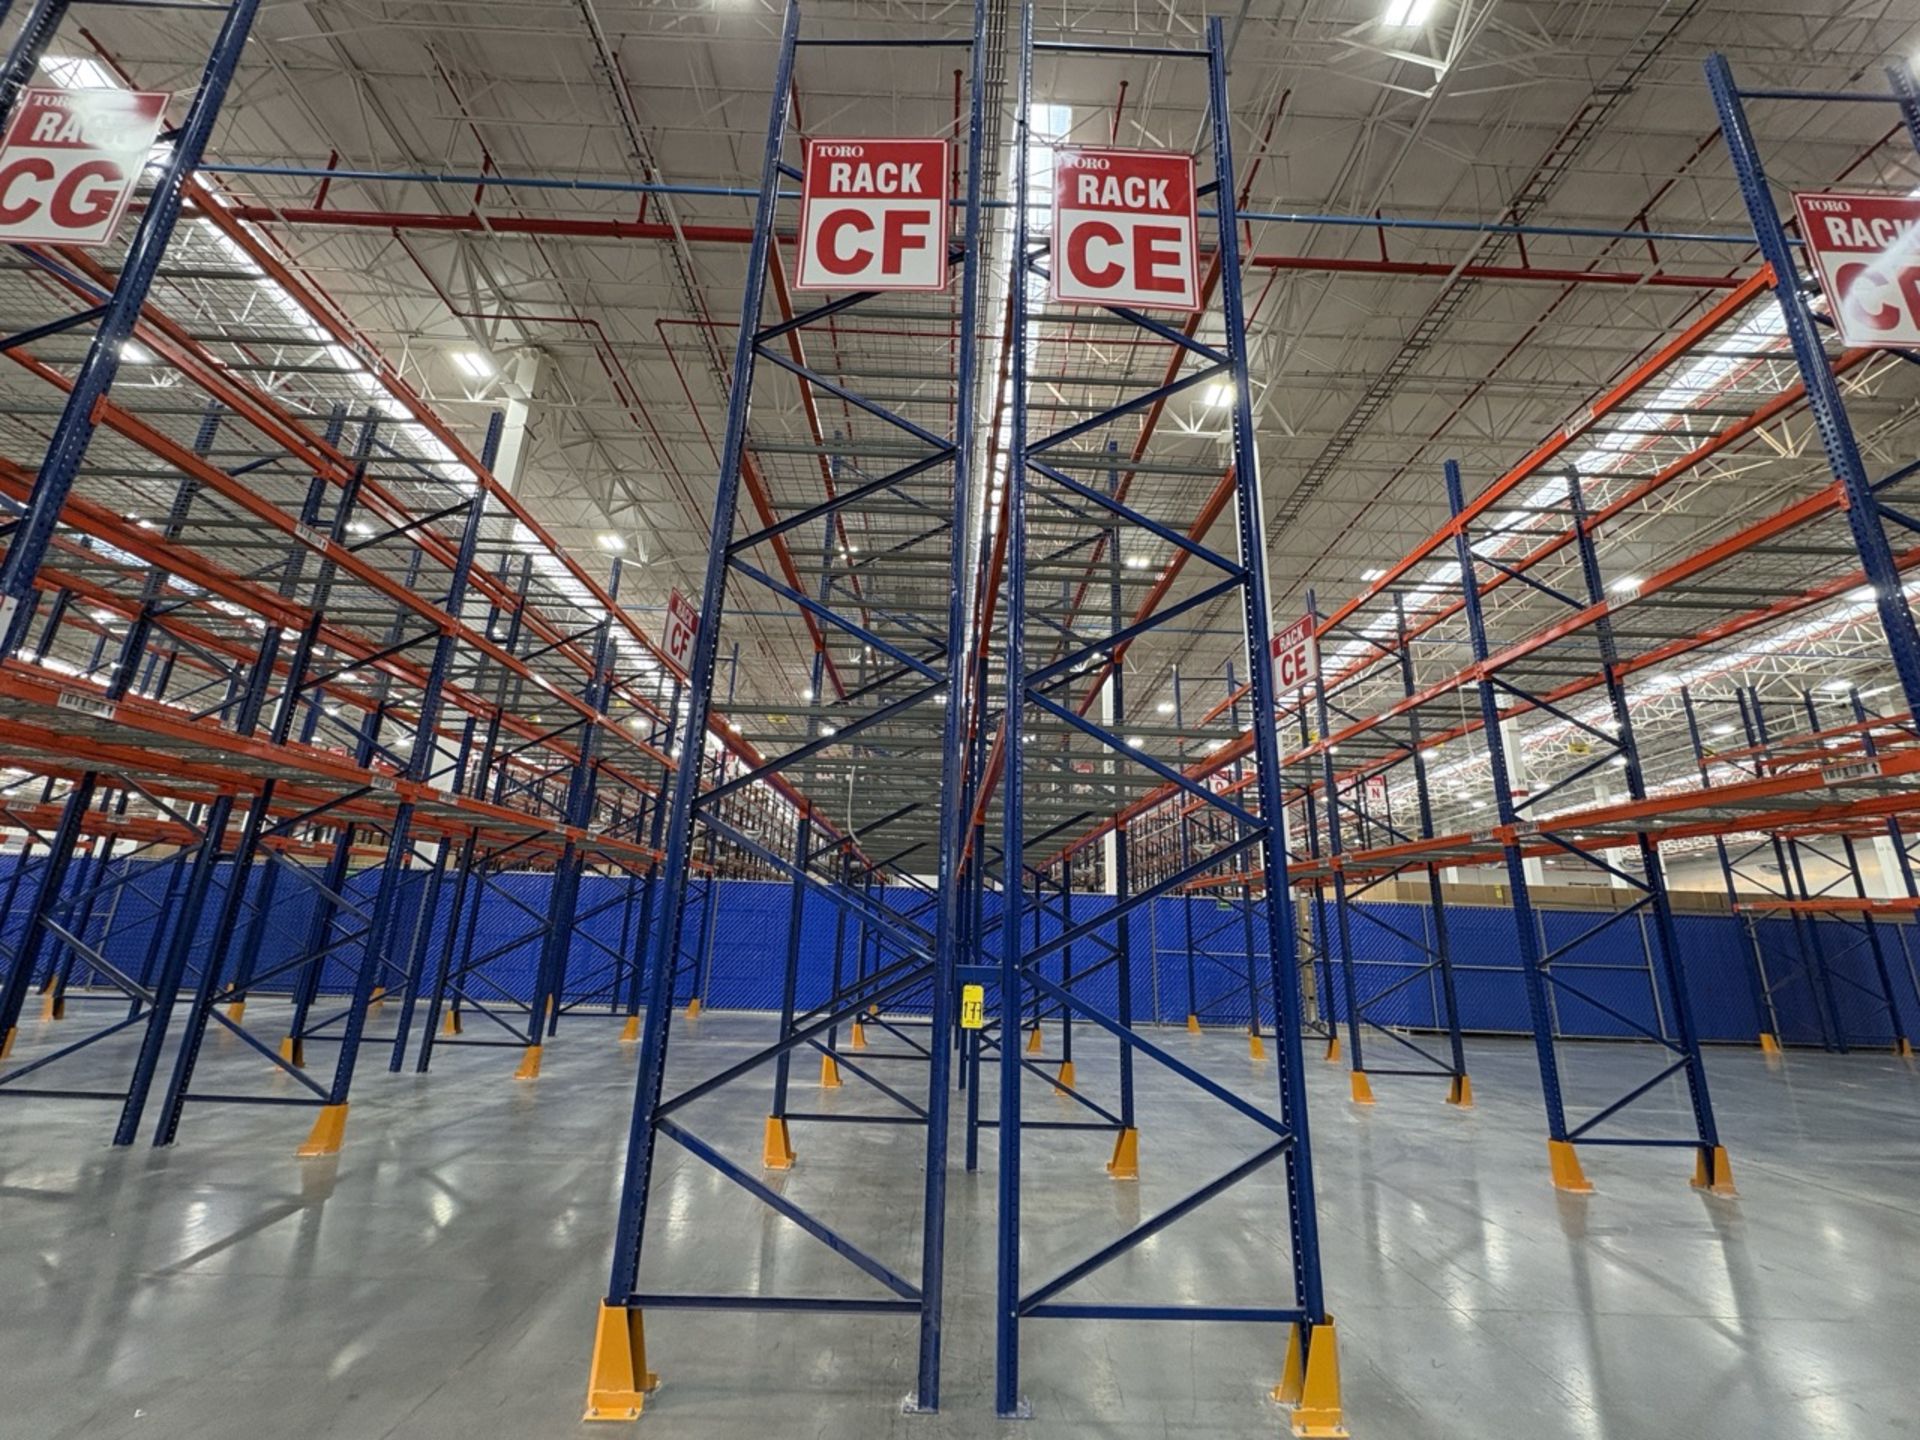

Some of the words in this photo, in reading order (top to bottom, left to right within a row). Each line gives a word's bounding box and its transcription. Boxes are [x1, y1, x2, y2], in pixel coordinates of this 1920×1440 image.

[30, 112, 137, 143] RAC
[817, 145, 864, 158] TORO
[0, 157, 124, 229] CG
[829, 162, 923, 193] RACK
[1078, 174, 1170, 209] RACK
[1804, 199, 1851, 213] TORO
[816, 208, 931, 276] CF
[1067, 220, 1186, 293] CE
[671, 622, 690, 661] CF
[1279, 623, 1305, 654] RACK
[1282, 644, 1308, 686] CE
